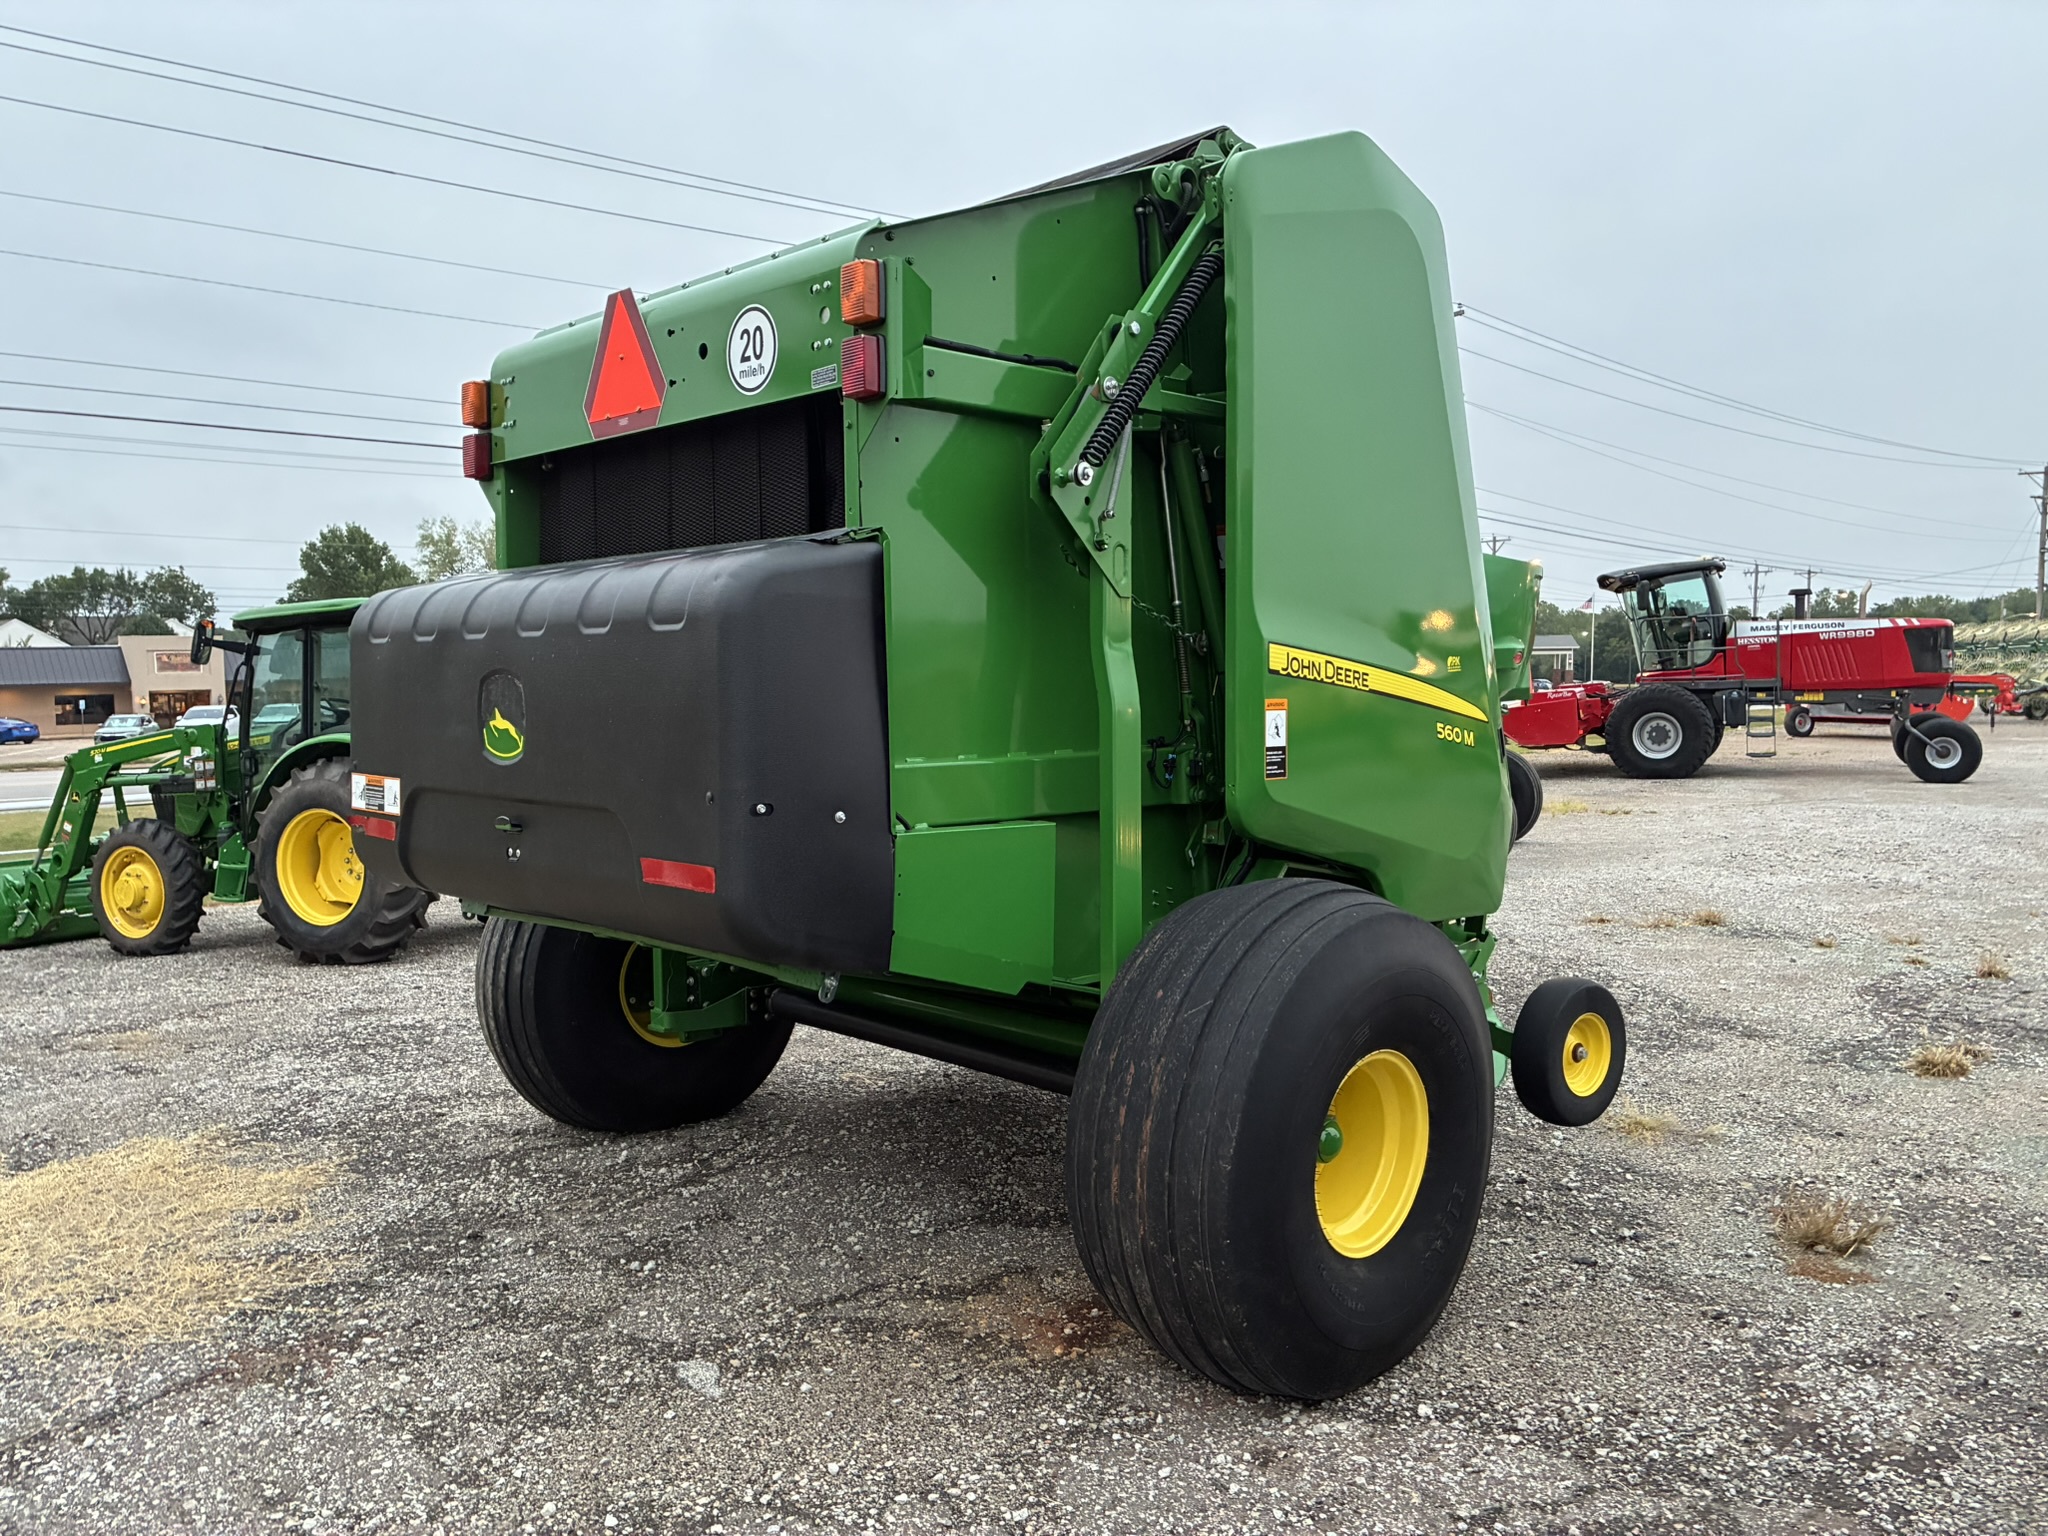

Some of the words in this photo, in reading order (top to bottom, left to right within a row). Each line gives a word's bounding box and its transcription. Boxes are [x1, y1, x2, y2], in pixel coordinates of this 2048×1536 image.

[740, 325, 764, 363] 20
[739, 363, 765, 380] mile/h
[1750, 624, 1789, 632] MASSEY
[1793, 622, 1845, 630] FERGUSON
[1819, 629, 1875, 640] WR9980
[1737, 637, 1777, 645] HESSTON
[1281, 652, 1321, 678] JOHN
[1325, 660, 1369, 688] DEERE
[1436, 722, 1462, 743] 560
[1464, 729, 1475, 746] M
